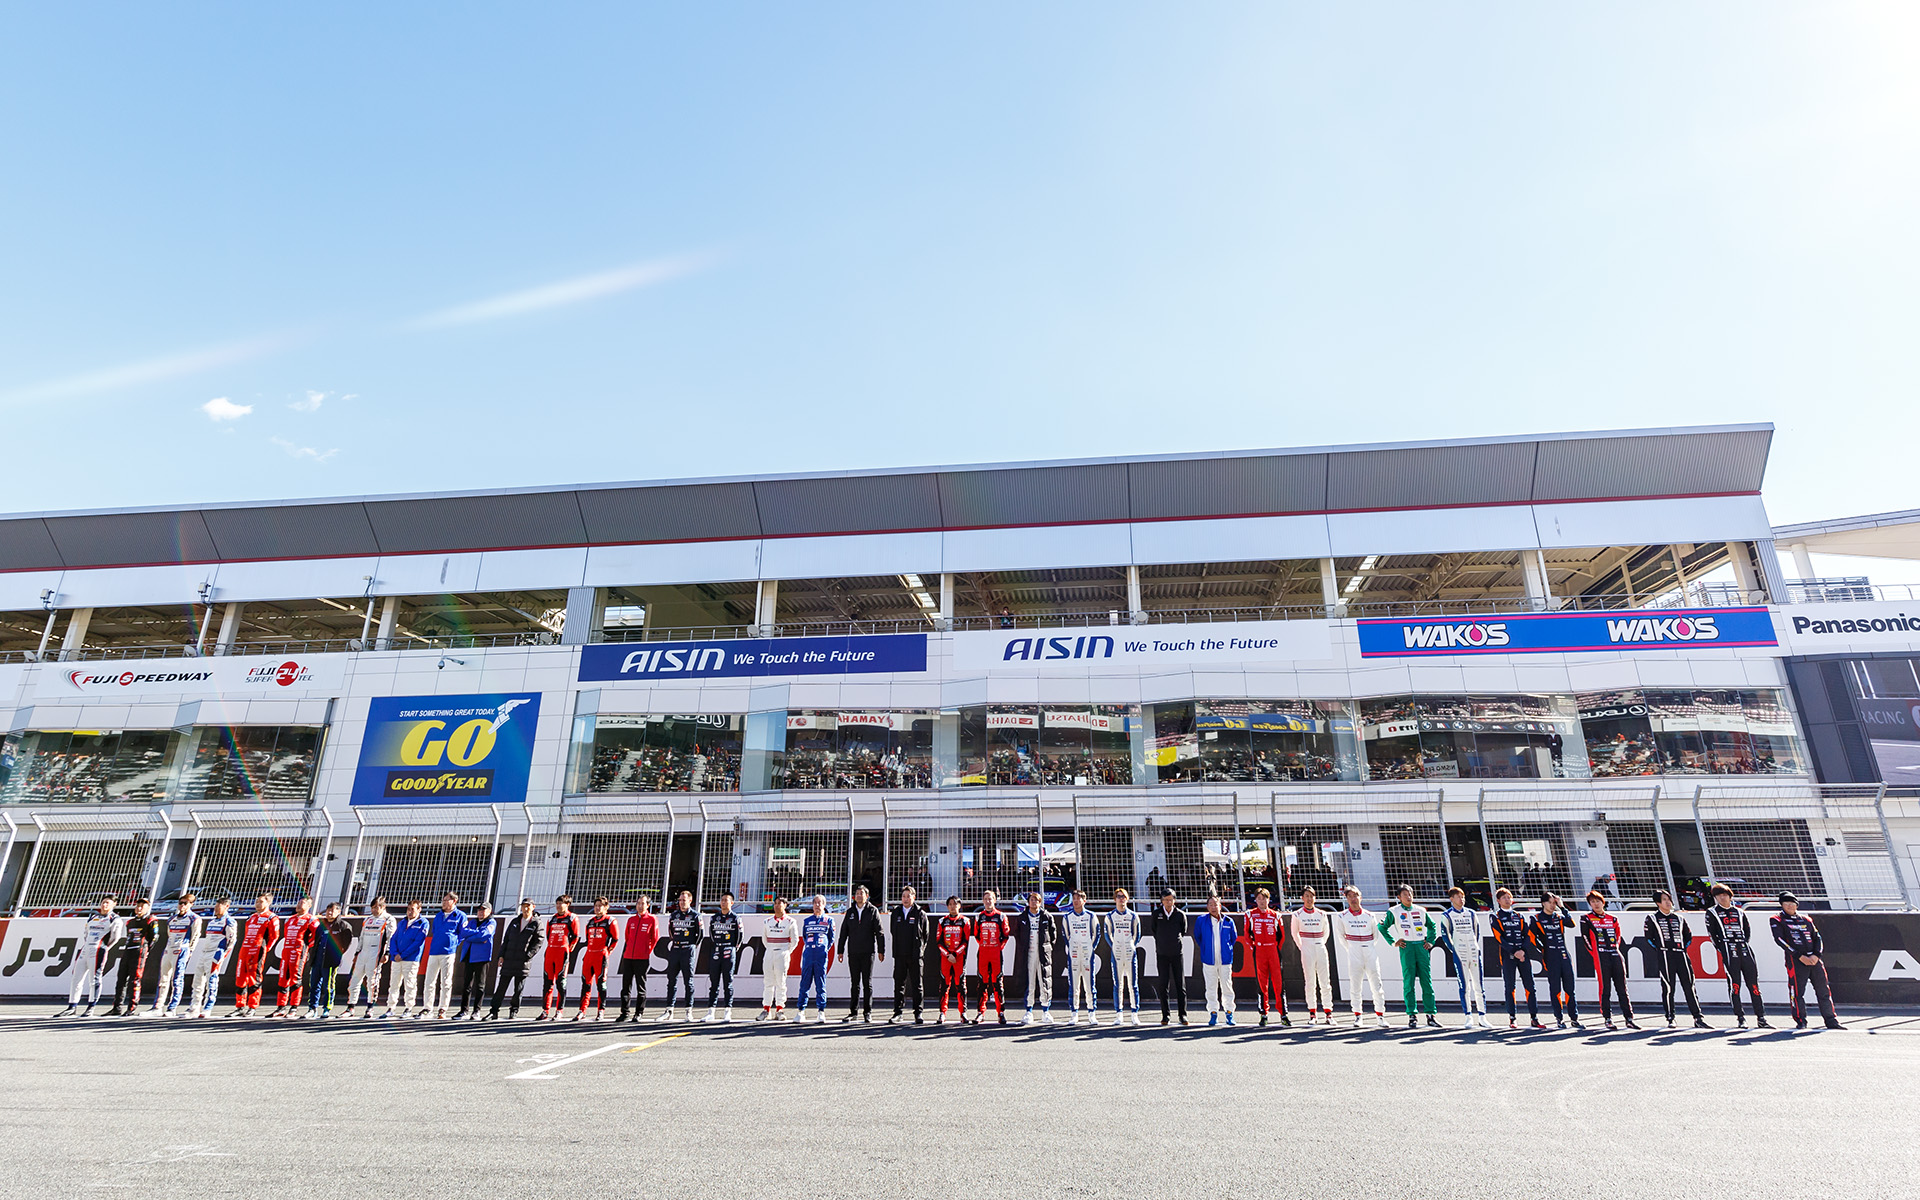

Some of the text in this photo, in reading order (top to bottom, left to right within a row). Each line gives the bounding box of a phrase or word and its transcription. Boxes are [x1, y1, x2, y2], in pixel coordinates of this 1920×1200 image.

[1402, 623, 1510, 648] WAKO'S
[1606, 616, 1720, 643] WAKO'S
[1792, 613, 1920, 635] Panasonic
[1002, 635, 1278, 661] AISIN We Touch the Future
[248, 667, 276, 676] FUJI
[620, 648, 875, 673] AISIN We Touch the Future
[82, 672, 213, 686] FUJI SPEEDWAY
[419, 709, 453, 717] SOMETHING
[400, 718, 497, 767] GO
[391, 775, 488, 791] GOODYEAR
